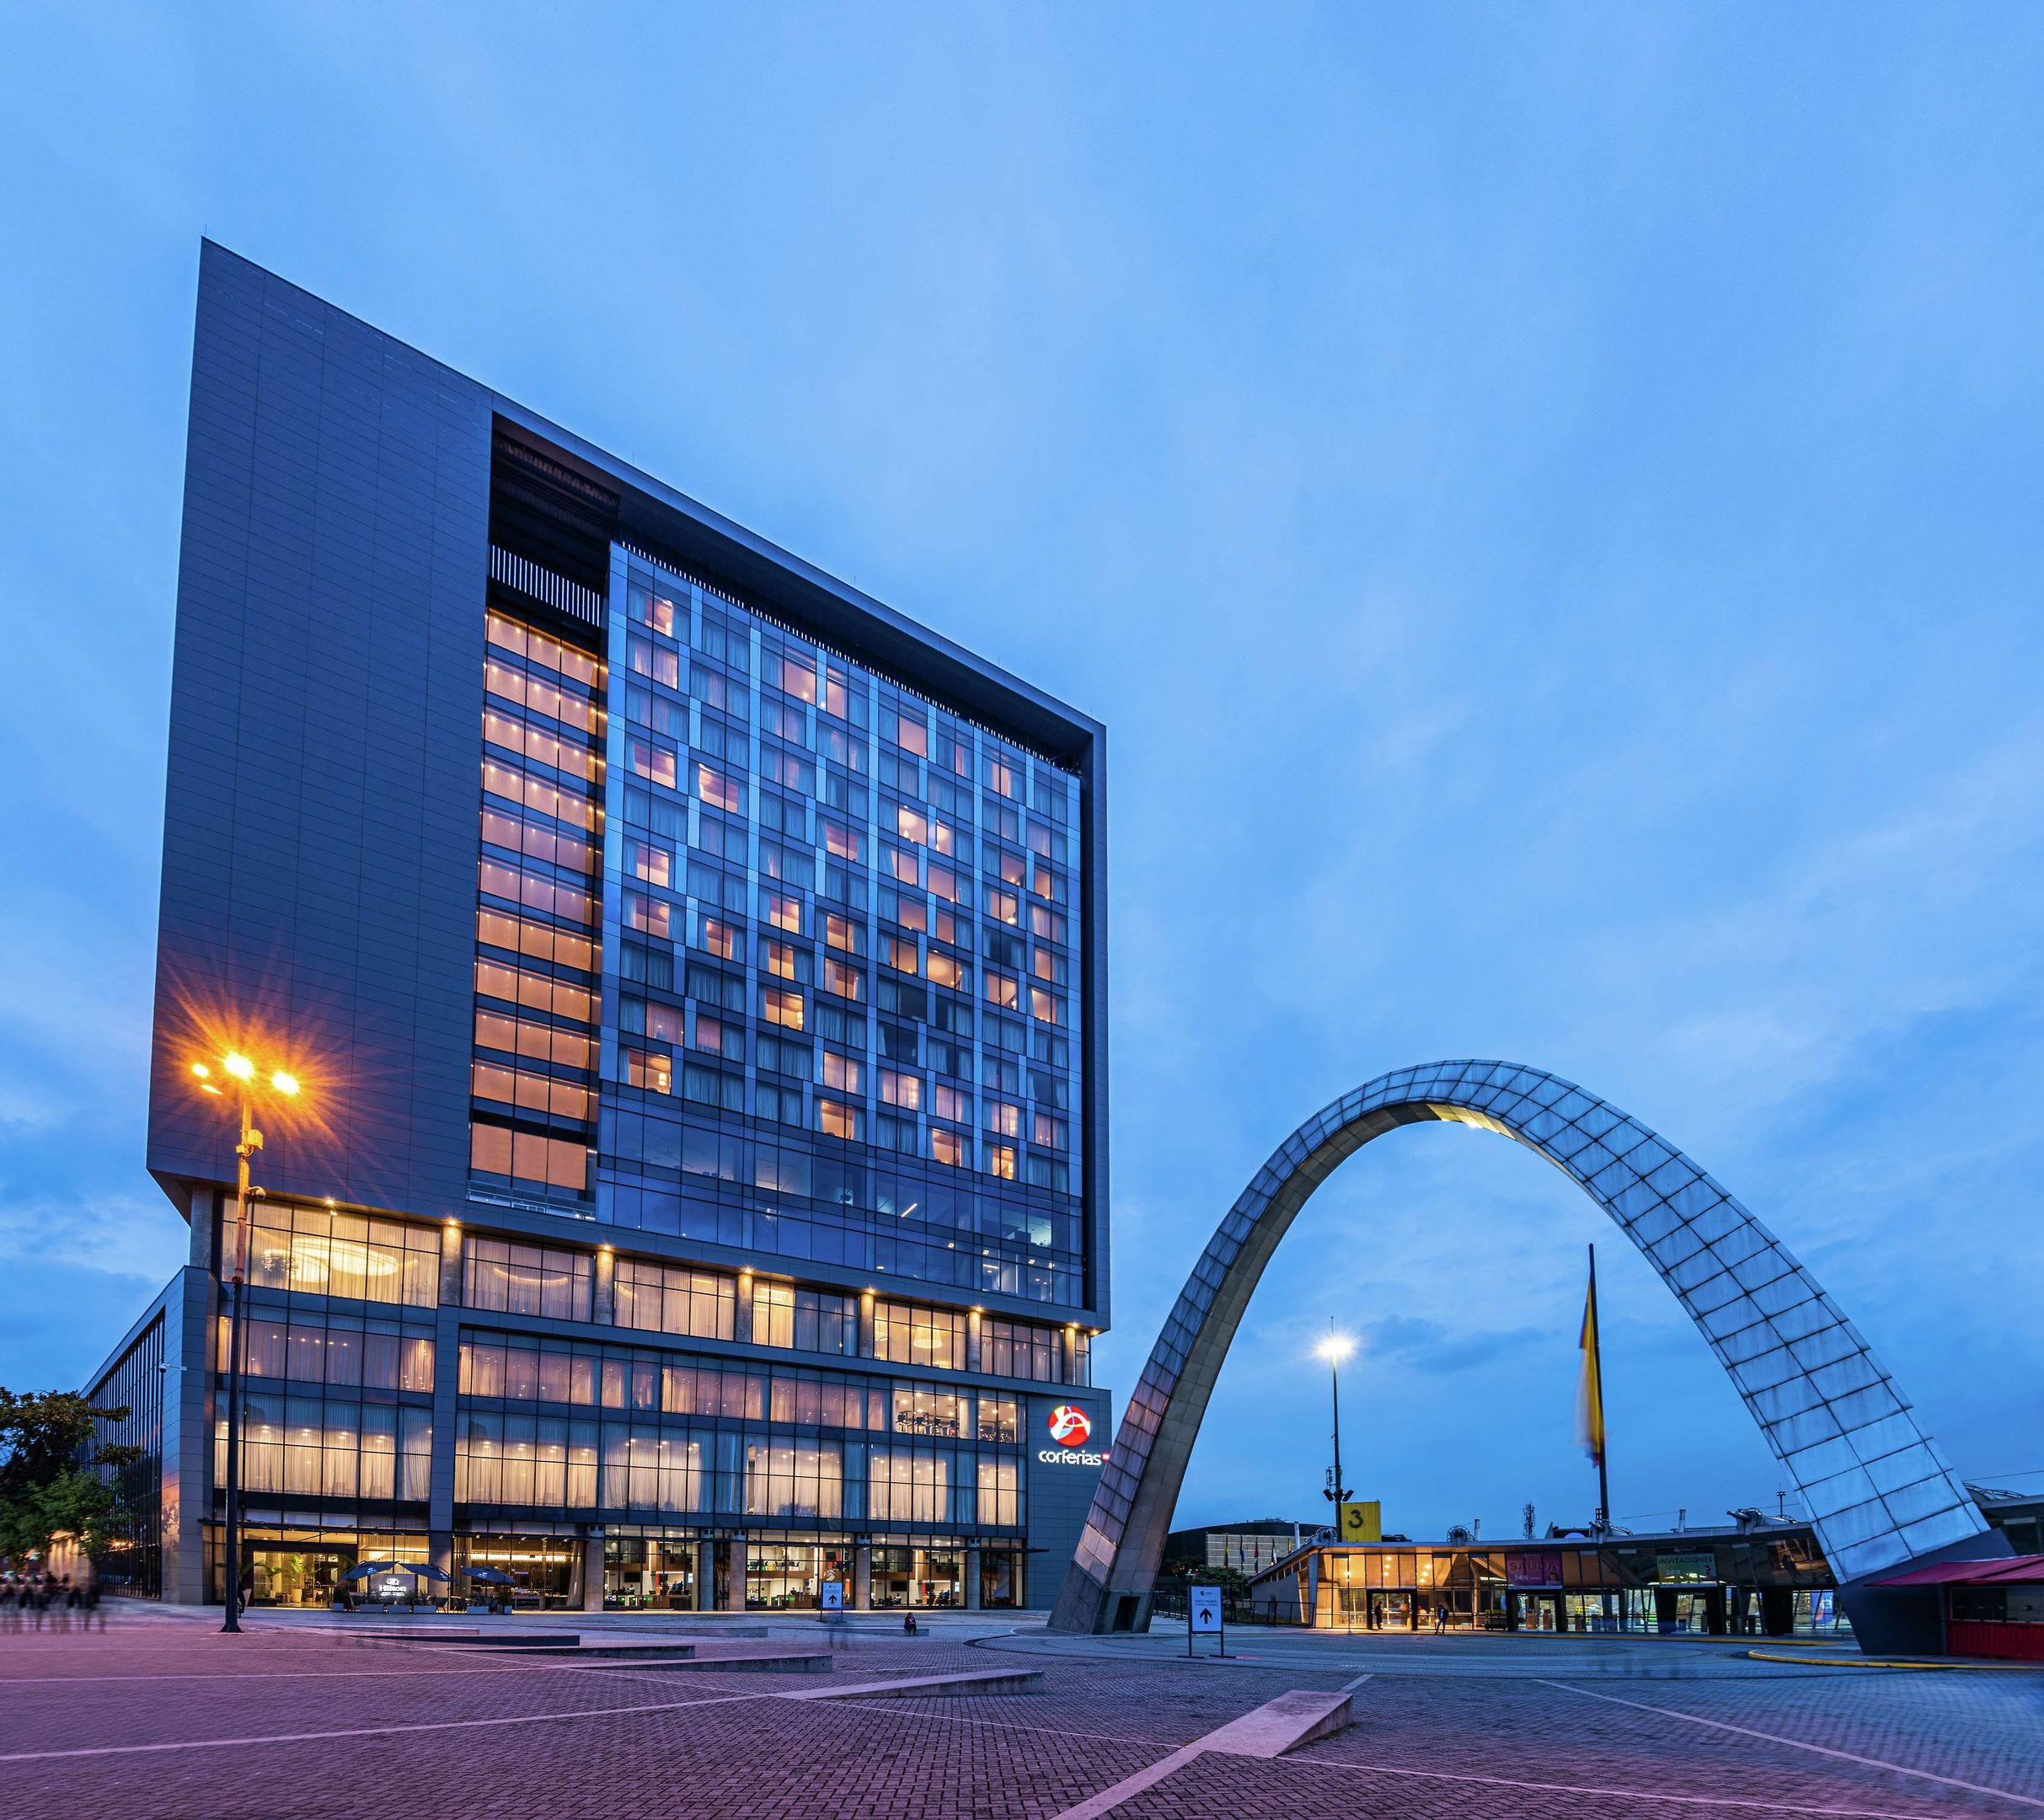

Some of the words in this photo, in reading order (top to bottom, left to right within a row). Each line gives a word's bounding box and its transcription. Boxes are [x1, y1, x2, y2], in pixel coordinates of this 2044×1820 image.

[1038, 1449, 1101, 1465] corferias
[1348, 1509, 1363, 1528] 3
[1510, 1561, 1559, 1572] SALIDA
[1658, 1556, 1713, 1565] INVITACIONES
